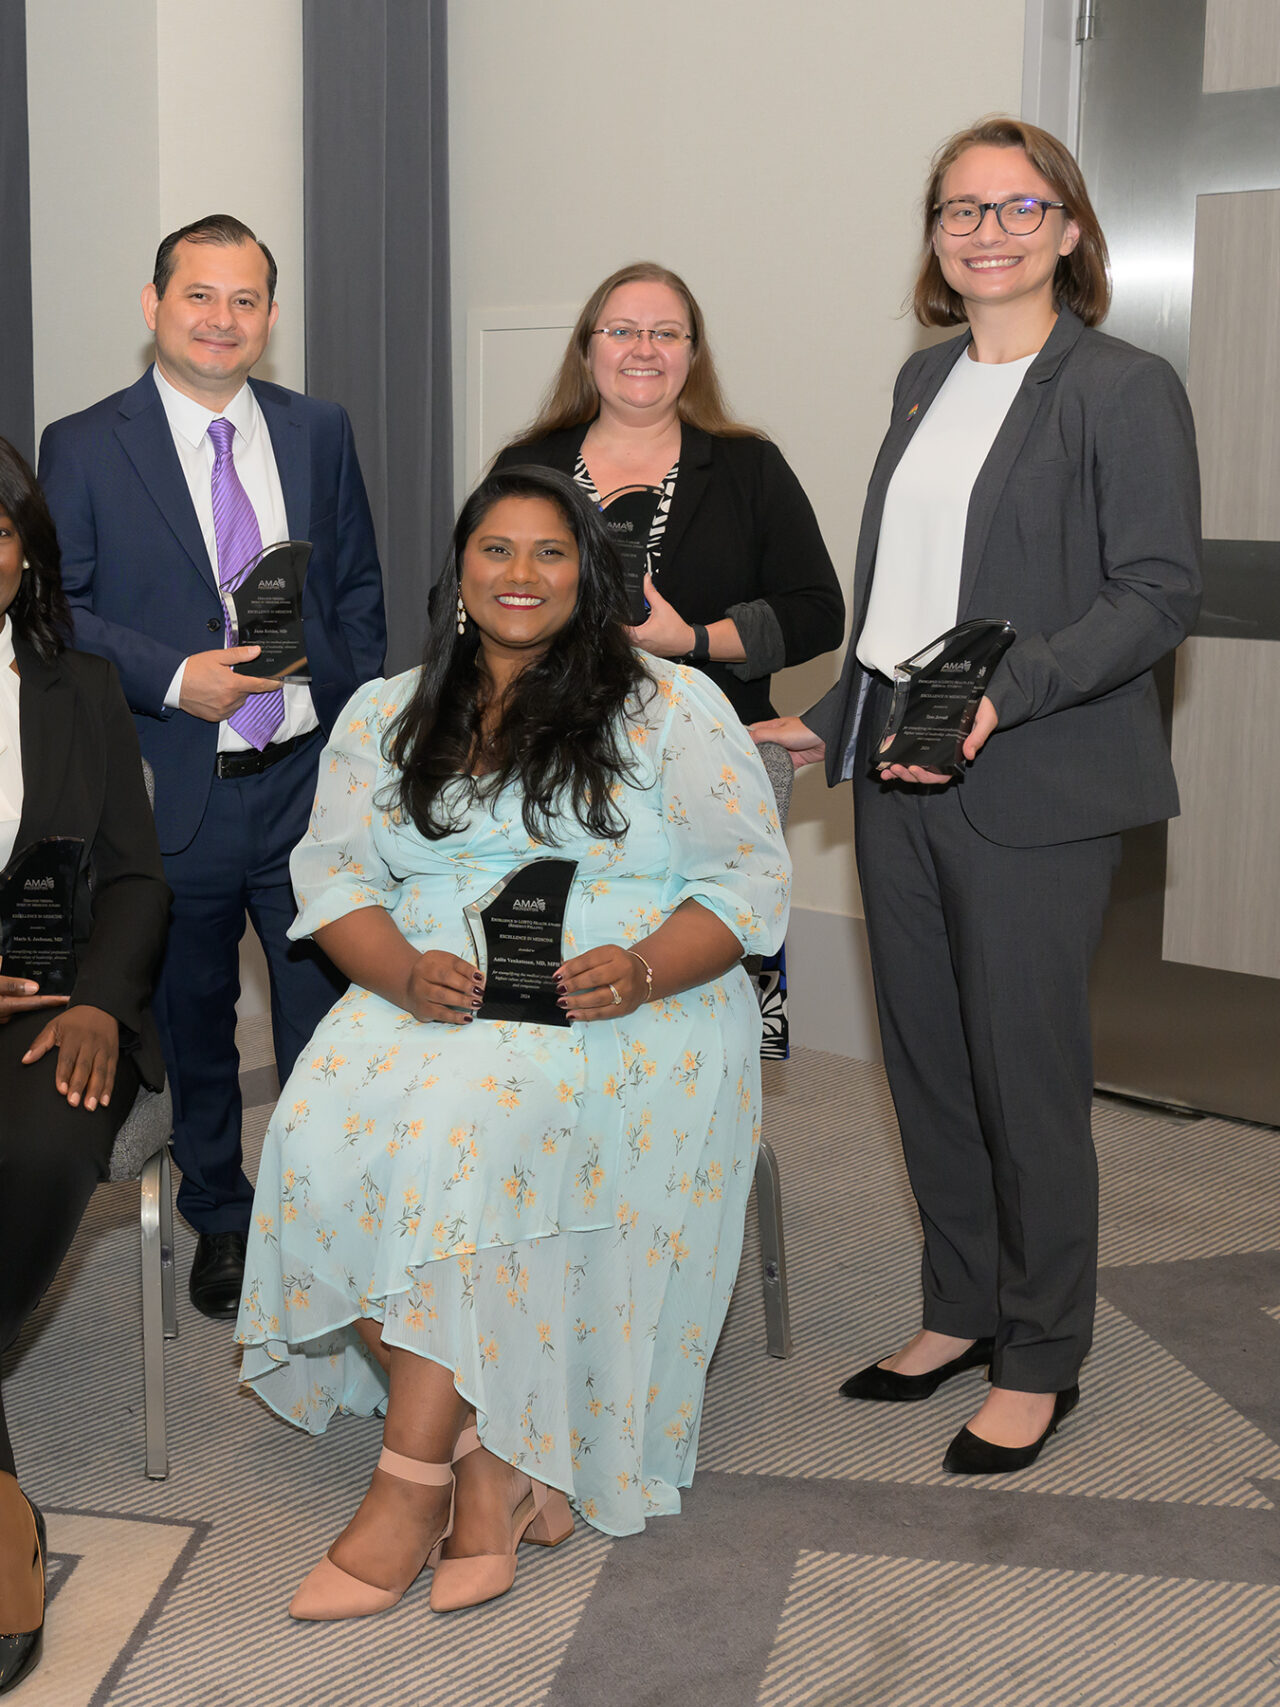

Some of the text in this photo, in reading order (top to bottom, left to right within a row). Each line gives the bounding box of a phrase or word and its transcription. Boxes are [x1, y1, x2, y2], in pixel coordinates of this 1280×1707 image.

[942, 662, 964, 670] AMA
[24, 879, 48, 887] AMA
[513, 899, 538, 909] AMA
